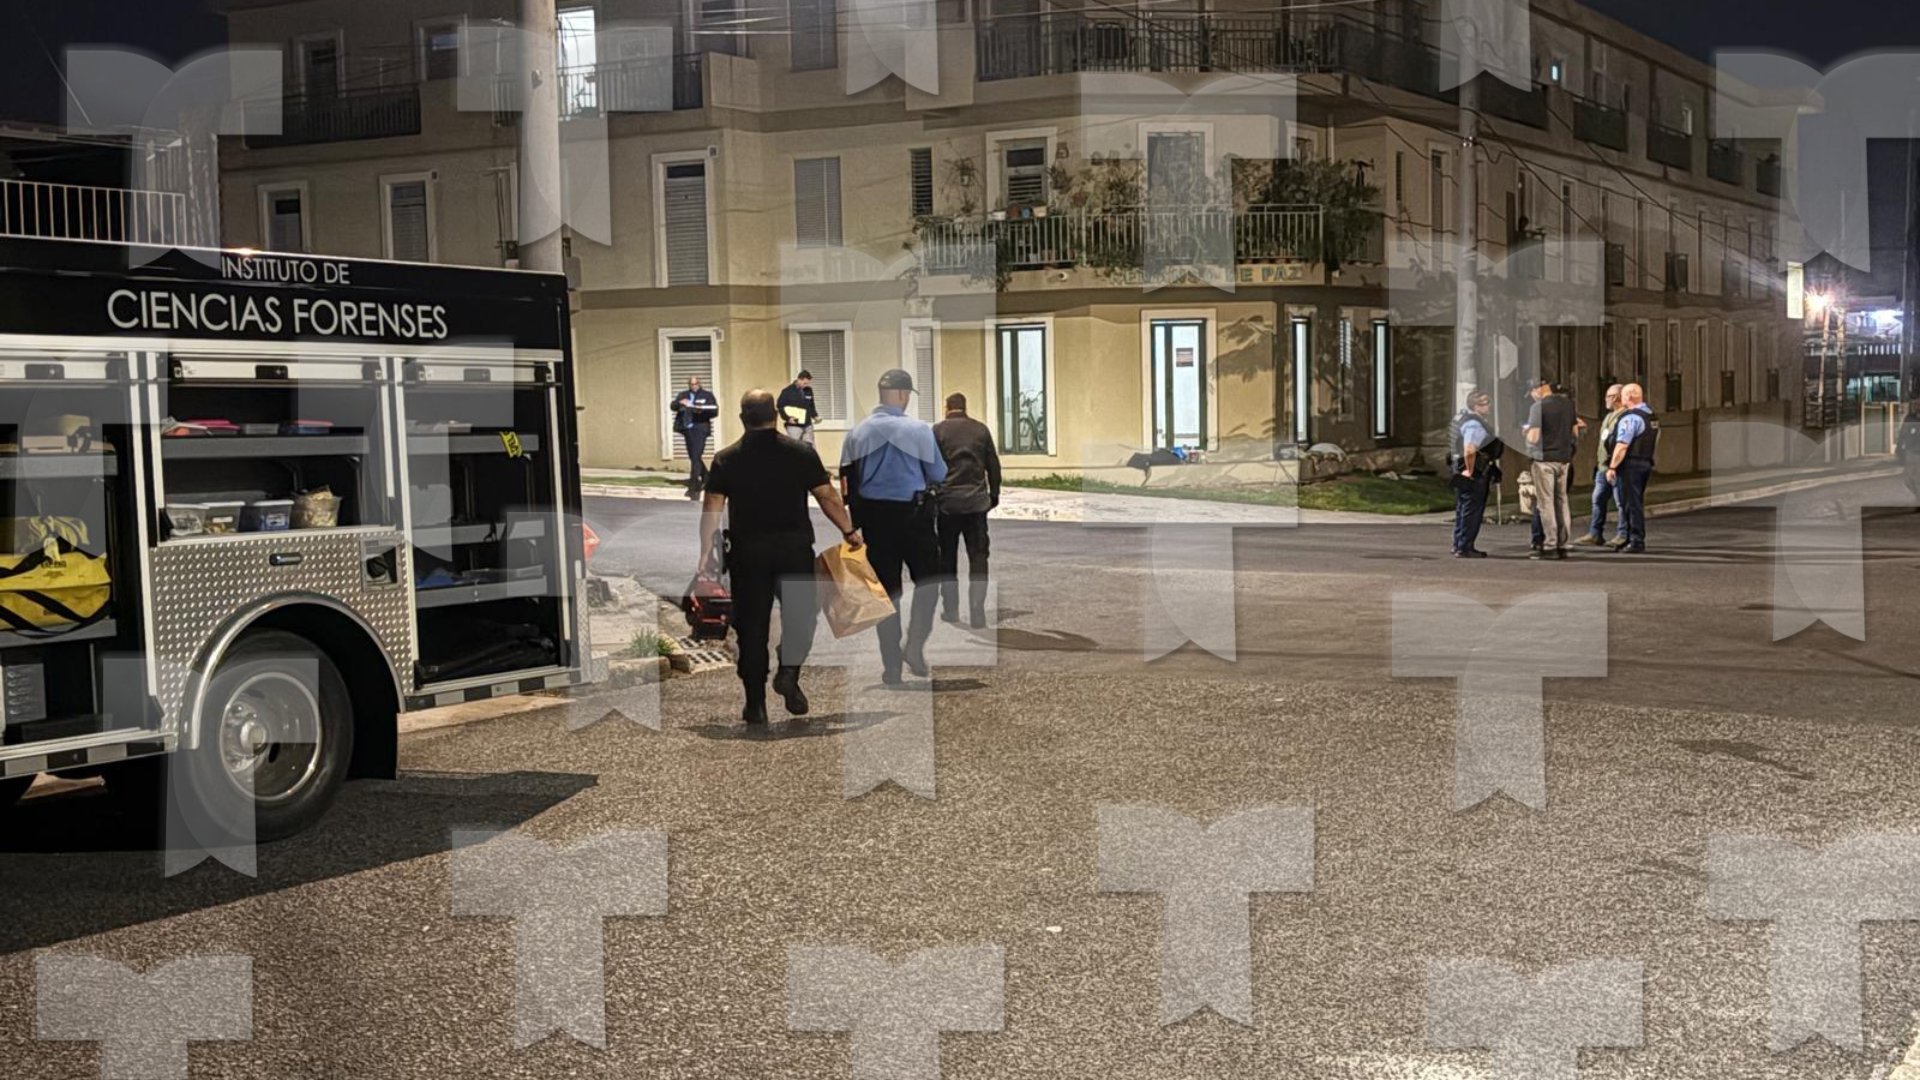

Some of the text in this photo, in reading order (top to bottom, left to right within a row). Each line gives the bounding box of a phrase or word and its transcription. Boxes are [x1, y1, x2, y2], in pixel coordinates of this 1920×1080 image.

[221, 255, 350, 285] INSTITUTO DE
[1261, 265, 1304, 283] PAZ
[107, 289, 448, 339] CIENCIAS FORENSES
